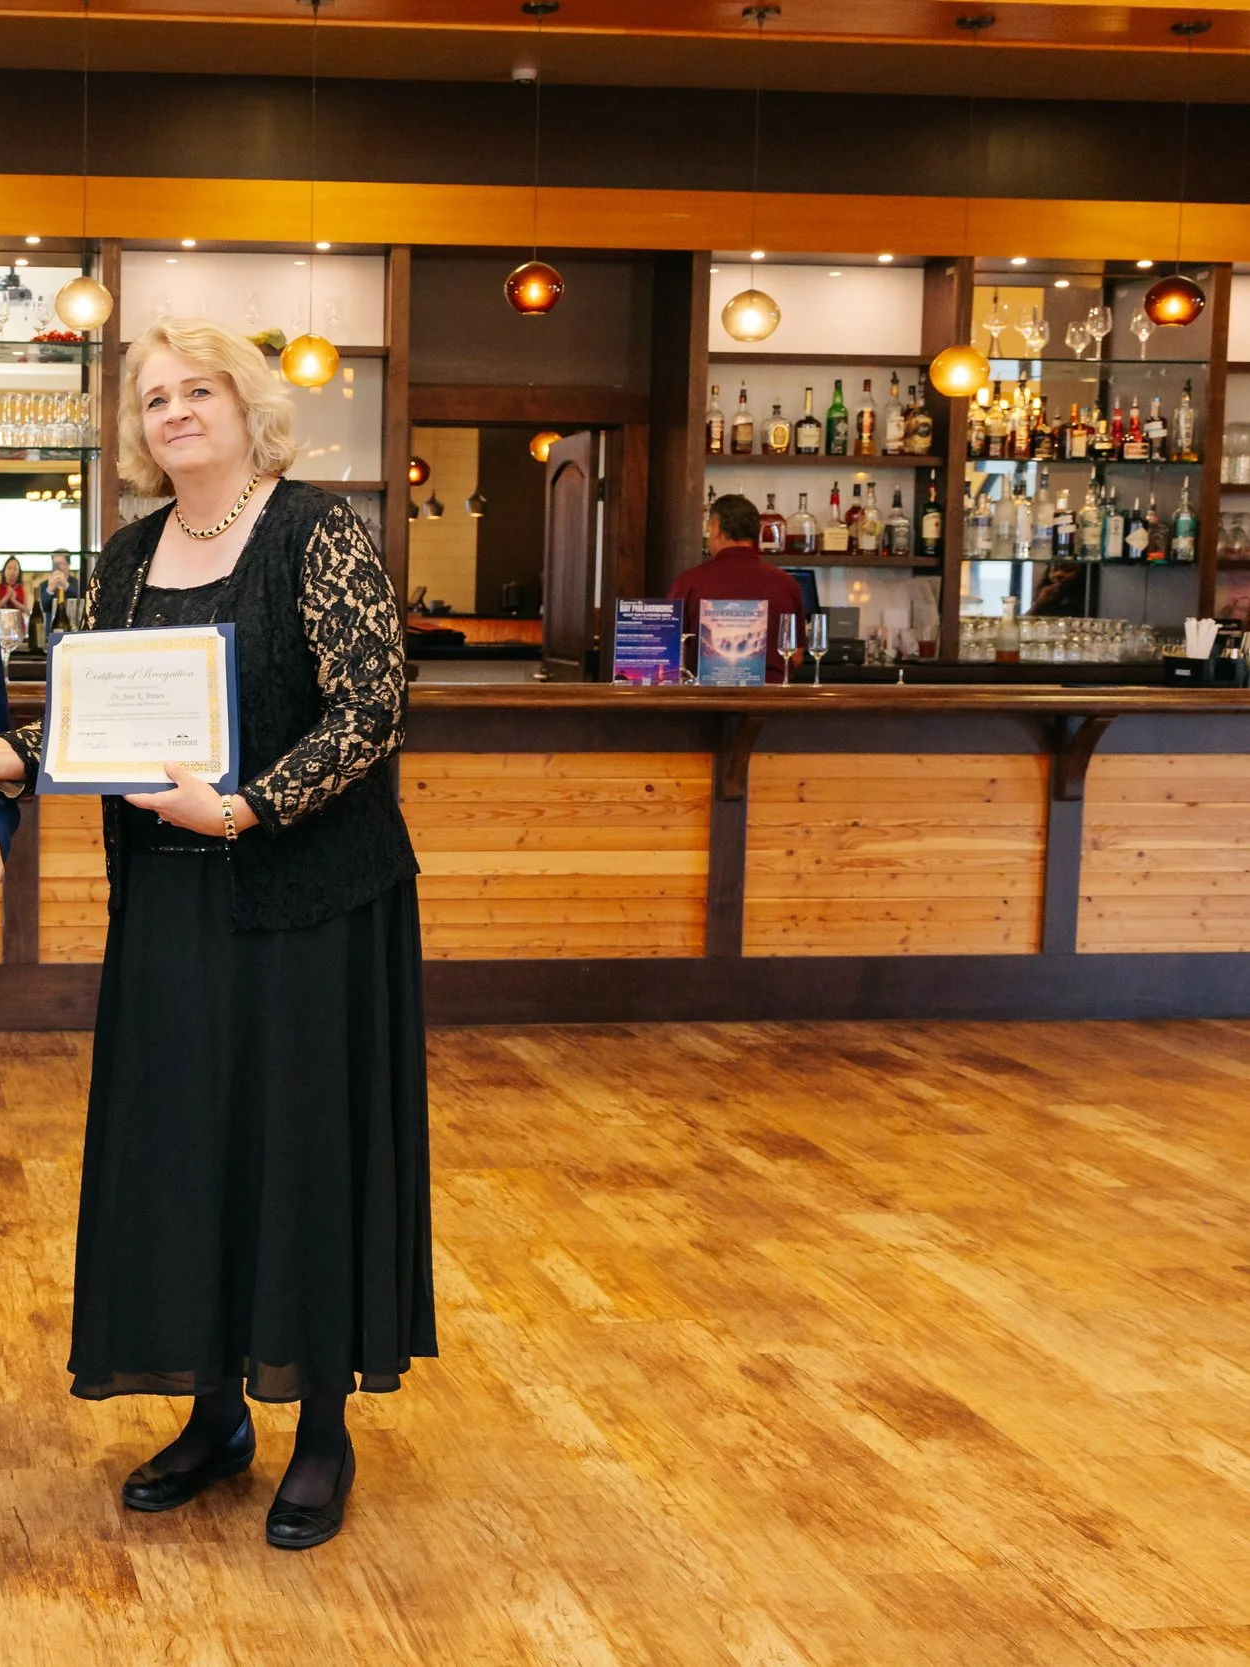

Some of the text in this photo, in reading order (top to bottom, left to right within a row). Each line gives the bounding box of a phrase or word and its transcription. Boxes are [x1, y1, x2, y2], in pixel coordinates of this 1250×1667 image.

[620, 604, 674, 613] BAY PHILHARMONIC
[84, 666, 194, 682] Certificate of Recognition
[168, 738, 198, 747] Fremont
